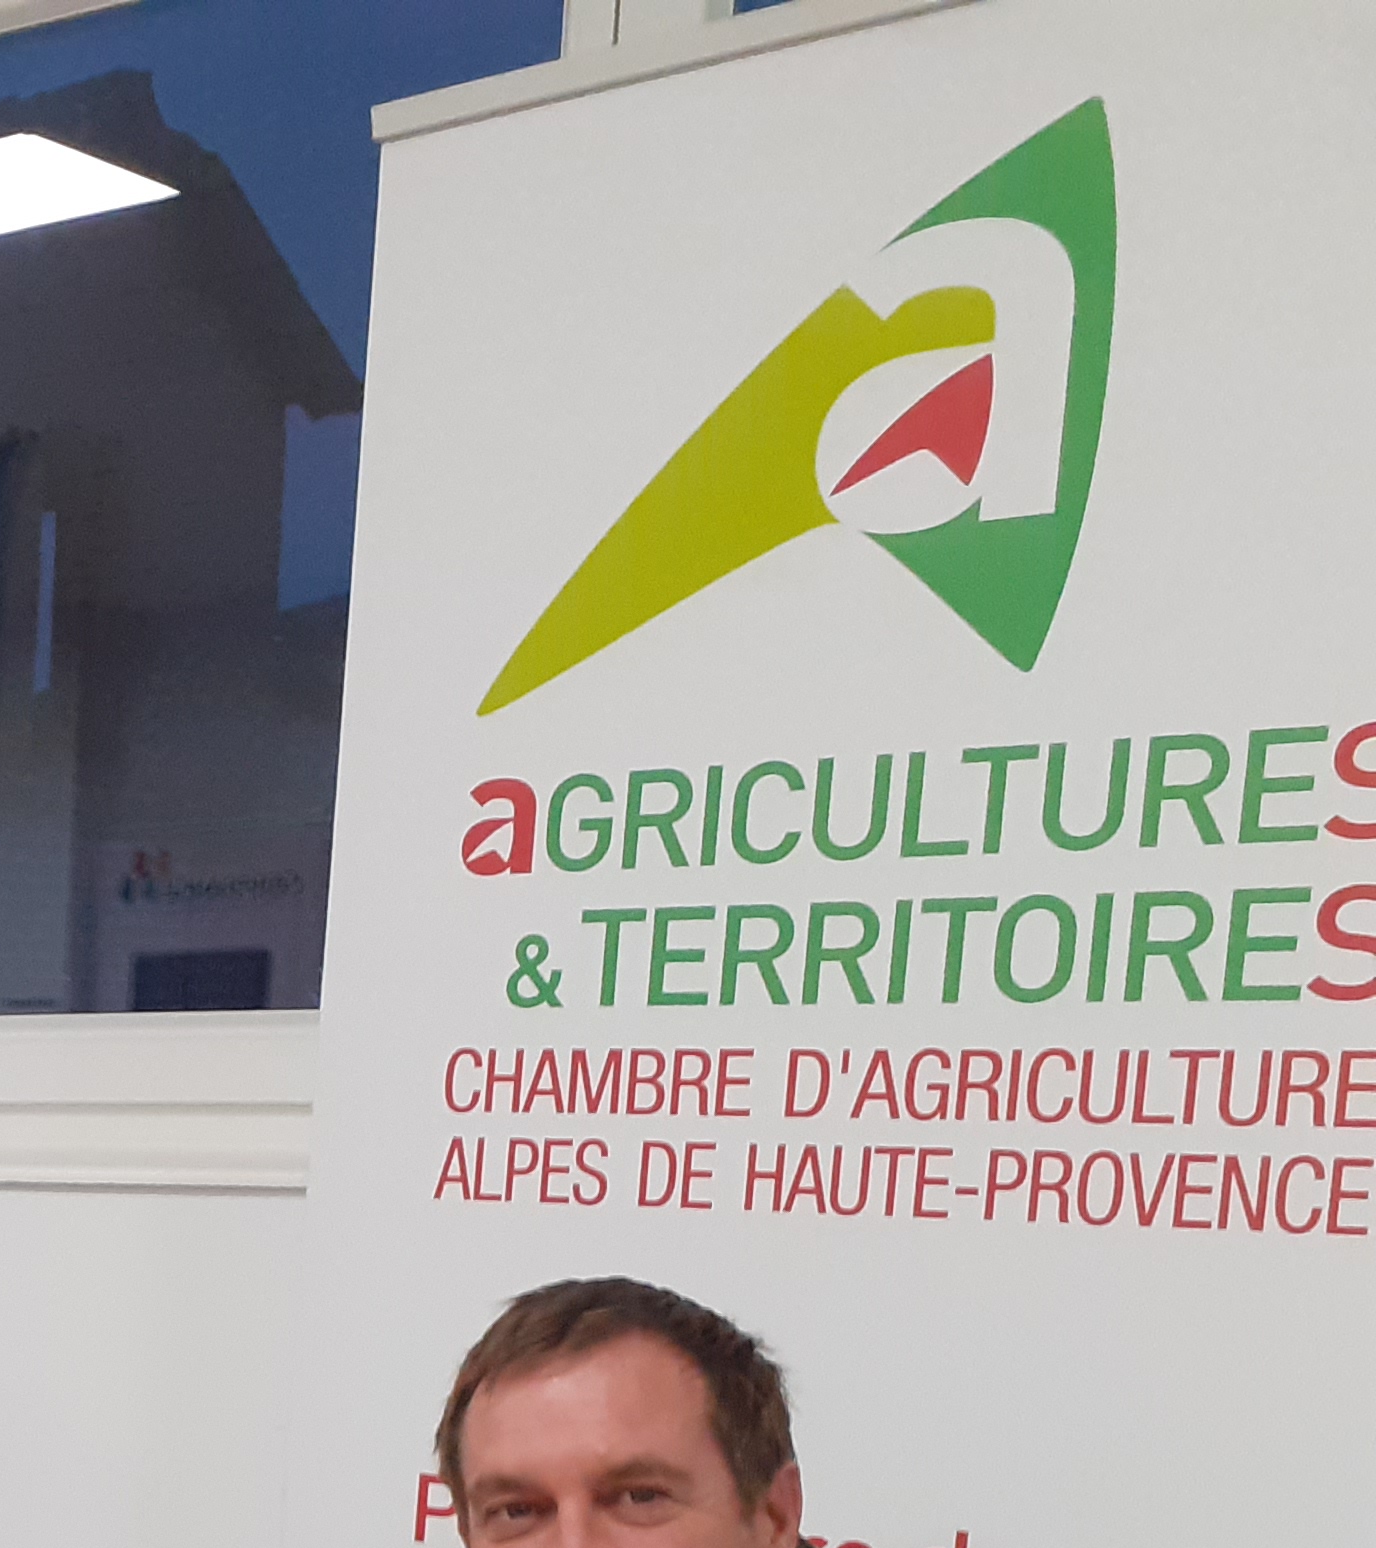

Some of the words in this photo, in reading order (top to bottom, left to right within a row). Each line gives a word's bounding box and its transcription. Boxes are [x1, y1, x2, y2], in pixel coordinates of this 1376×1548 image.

[504, 933, 564, 1009] &
[580, 883, 1376, 1008] TERRITOIRES
[444, 1046, 755, 1117] CHAMBRE
[783, 1047, 1376, 1129] D'AGRICULTURE
[432, 1136, 609, 1206] ALPES
[637, 1141, 718, 1209] DE
[742, 1144, 1375, 1236] HAUTE-PROVENCE
